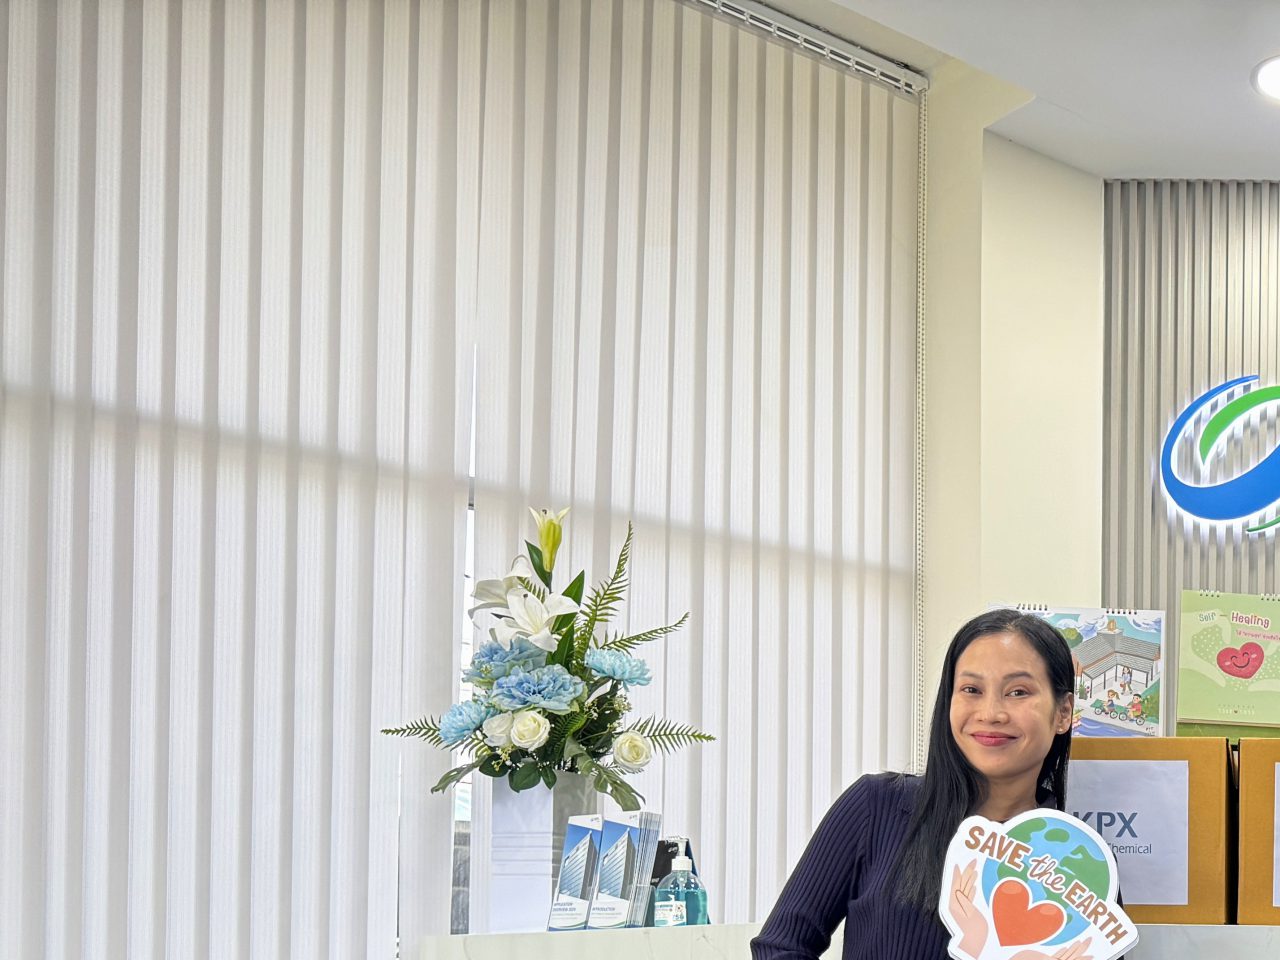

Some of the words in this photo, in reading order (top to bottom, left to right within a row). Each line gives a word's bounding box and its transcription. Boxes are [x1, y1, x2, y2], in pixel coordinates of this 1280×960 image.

[1199, 612, 1216, 622] Self
[1231, 612, 1270, 629] Healing
[1073, 811, 1138, 838] PX
[1107, 843, 1152, 854] hemical
[965, 825, 1031, 870] SAVE
[1031, 855, 1065, 891] the
[1064, 882, 1129, 946] EARTH
